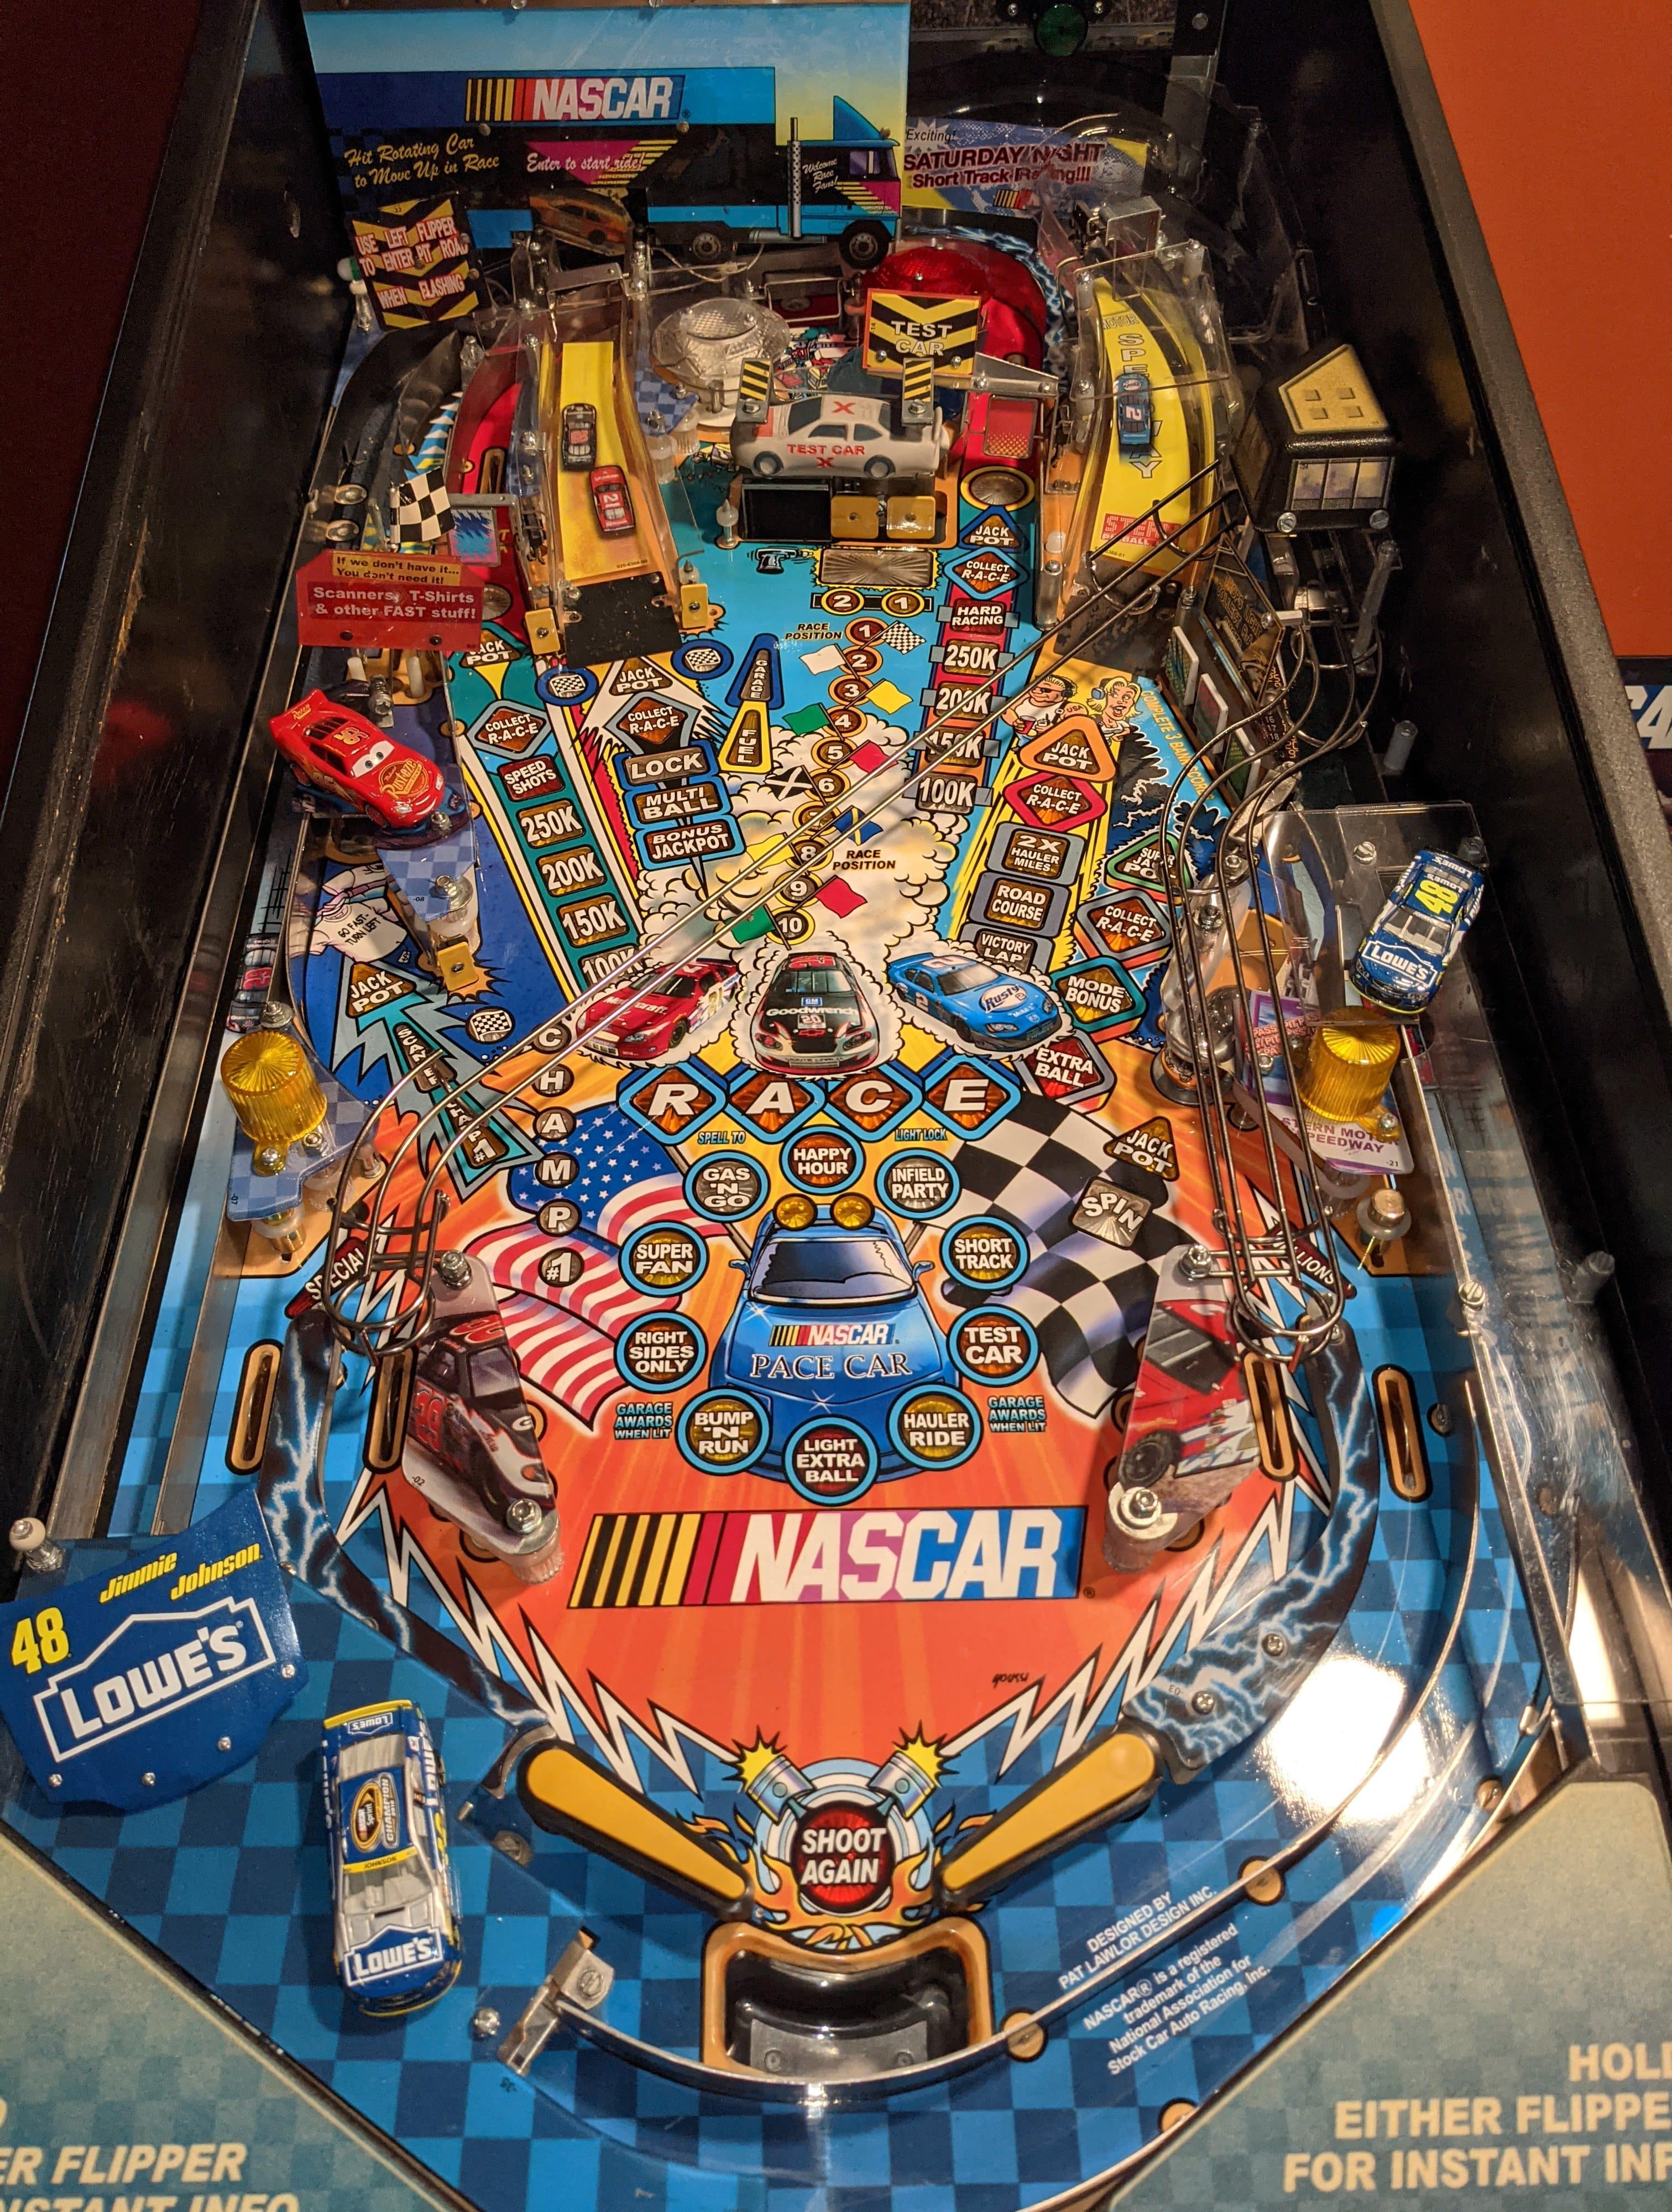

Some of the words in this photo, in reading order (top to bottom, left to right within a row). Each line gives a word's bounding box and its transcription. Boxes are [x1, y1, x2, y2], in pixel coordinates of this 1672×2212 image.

[532, 77, 673, 121] NASCAR
[906, 128, 957, 143] Exciting!
[344, 147, 373, 167] Hit
[378, 142, 440, 163] Rotating
[446, 133, 474, 155] Car
[904, 145, 1026, 171] SATURDAY
[354, 173, 367, 188] to
[369, 168, 411, 186] Move
[415, 160, 440, 179] Up
[444, 159, 458, 174] in
[462, 154, 500, 170] Race
[527, 153, 561, 173] Enter
[565, 156, 576, 170] to
[580, 154, 609, 170] start
[613, 152, 645, 170] ride!
[912, 171, 959, 189] Short
[964, 166, 1013, 186] Track
[356, 233, 379, 255] USE
[385, 227, 409, 249] LEFT
[416, 216, 457, 242] FLIPPER
[359, 256, 376, 276] TO
[382, 248, 415, 272] ENTER
[416, 242, 433, 263] PIT
[377, 286, 408, 310] WHEN
[419, 274, 466, 301] FLASHING
[891, 320, 952, 338] TEST
[896, 340, 944, 357] CAR
[787, 444, 826, 455] TEST
[832, 444, 865, 456] CAR
[337, 556, 347, 566] If
[350, 559, 368, 567] we
[372, 560, 404, 571] don't
[407, 561, 436, 573] have
[336, 568, 359, 578] You
[363, 570, 394, 581] don't
[398, 572, 429, 584] need
[432, 575, 445, 585] it!
[314, 587, 399, 602] Scanners,
[410, 589, 475, 604] T-Shirts
[315, 605, 328, 615] &
[334, 604, 379, 617] other
[384, 606, 426, 618] FAST
[431, 607, 476, 619] stuff!
[952, 615, 1004, 627] RACING
[957, 606, 1002, 615] HARD
[785, 631, 843, 640] POSITION
[797, 623, 829, 632] RACE
[944, 644, 999, 670] 250K
[750, 659, 767, 700] GARAGE
[1141, 690, 1176, 733] COMPLETE
[485, 713, 531, 733] COLLECT
[488, 722, 539, 745] R-A-C-E
[737, 728, 757, 764] FUEL
[504, 760, 547, 784] SPEED
[630, 752, 704, 780] LOCK
[512, 769, 557, 795] SHOTS
[919, 777, 976, 808] 100K
[642, 795, 718, 820] BALL
[645, 787, 705, 806] MULTI
[520, 805, 583, 843] 250K
[652, 824, 723, 845] BONUS
[651, 833, 730, 859] JACKPOT
[1011, 847, 1061, 865] HAULER
[1014, 857, 1052, 873] MILES
[996, 884, 1047, 905] ROAD
[1414, 879, 1459, 915] 48
[990, 897, 1044, 922] COURSE
[338, 927, 351, 938] GO
[344, 930, 367, 946] TURN
[363, 916, 382, 933] LEFT
[980, 932, 1032, 954] VICTORY
[983, 946, 1026, 964] LAP
[1370, 945, 1429, 981] LOWE'S
[1067, 974, 1127, 999] MODE
[766, 1006, 858, 1017] Goodwrench
[1064, 988, 1122, 1015] BONUS
[1036, 1047, 1094, 1074] EXTRA
[1034, 1065, 1085, 1088] BALL
[647, 1083, 699, 1116] R
[745, 1081, 796, 1116] A
[845, 1079, 892, 1114] C
[943, 1079, 990, 1112] E
[697, 1131, 729, 1145] SPELL
[731, 1131, 746, 1144] TO
[895, 1129, 921, 1142] LIGHT
[922, 1129, 947, 1141] LOCK
[1126, 1129, 1173, 1159] JACK
[793, 1147, 852, 1162] HAPPY
[1112, 1142, 1173, 1174] POT
[702, 1167, 751, 1182] GAS
[797, 1162, 849, 1176] HOUR
[891, 1167, 945, 1183] INFIELD
[703, 1195, 744, 1208] GO
[891, 1182, 950, 1200] PARTY
[1081, 1192, 1144, 1232] SPIN
[636, 1243, 694, 1260] SUPER
[954, 1238, 1013, 1254] SHORT
[635, 1260, 694, 1275] FAN
[956, 1253, 1014, 1270] TRACK
[635, 1331, 688, 1345] RIGHT
[807, 1323, 890, 1345] NASCAR
[629, 1345, 695, 1360] SIDES
[635, 1359, 689, 1375] ONLY
[749, 1353, 834, 1379] PACE
[843, 1353, 913, 1379] CAR
[616, 1402, 673, 1415] GARAGE
[694, 1411, 754, 1426] BUMP
[615, 1415, 673, 1428] AWARDS
[903, 1412, 970, 1429] HAULER
[614, 1428, 650, 1440] WHEN
[652, 1427, 673, 1439] LIT
[910, 1430, 967, 1447] RIDE
[698, 1439, 749, 1455] RUN
[803, 1438, 858, 1452] LIGHT
[796, 1452, 865, 1468] EXTRA
[805, 1469, 859, 1483] BALL
[729, 1510, 1062, 1603] NASCAR
[11, 1606, 70, 1674] 48
[98, 1552, 178, 1603] Jimmie
[170, 1542, 261, 1600] Johnson
[60, 1625, 247, 1739] LOWE'S
[801, 1827, 887, 1854] SHOOT
[364, 1856, 398, 1870] JOHNSON
[800, 1858, 879, 1885] AGAIN
[1086, 1905, 1154, 1953] DESIGNED
[1152, 1891, 1173, 1912] BY
[1058, 1967, 1085, 1990] PAT
[1084, 1933, 1143, 1974] LAWLOR
[1139, 1901, 1191, 1939] DESIGN
[1187, 1885, 1218, 1907] INC.
[354, 1937, 433, 1979] LOWE'S
[1153, 1971, 1167, 1985] is
[1169, 1965, 1178, 1976] a
[1177, 1922, 1239, 1971] registered
[1122, 1979, 1187, 2025] trademark
[1186, 1968, 1201, 1984] of
[1199, 1955, 1222, 1973] the
[1108, 2014, 1162, 2054] National
[1160, 1972, 1232, 2019] Association
[1231, 1955, 1252, 1975] for
[1106, 2046, 1147, 2076] Stock
[1145, 2031, 1169, 2049] Car
[1169, 2013, 1201, 2036] Auto
[1198, 1983, 1248, 2016] Racing,
[1245, 1965, 1272, 1983] Inc.
[1335, 2096, 1503, 2140] EITHER
[51, 2142, 247, 2184] FLIPPER
[1284, 2151, 1377, 2193] FOR
[1390, 2144, 1591, 2190] INSTANT
